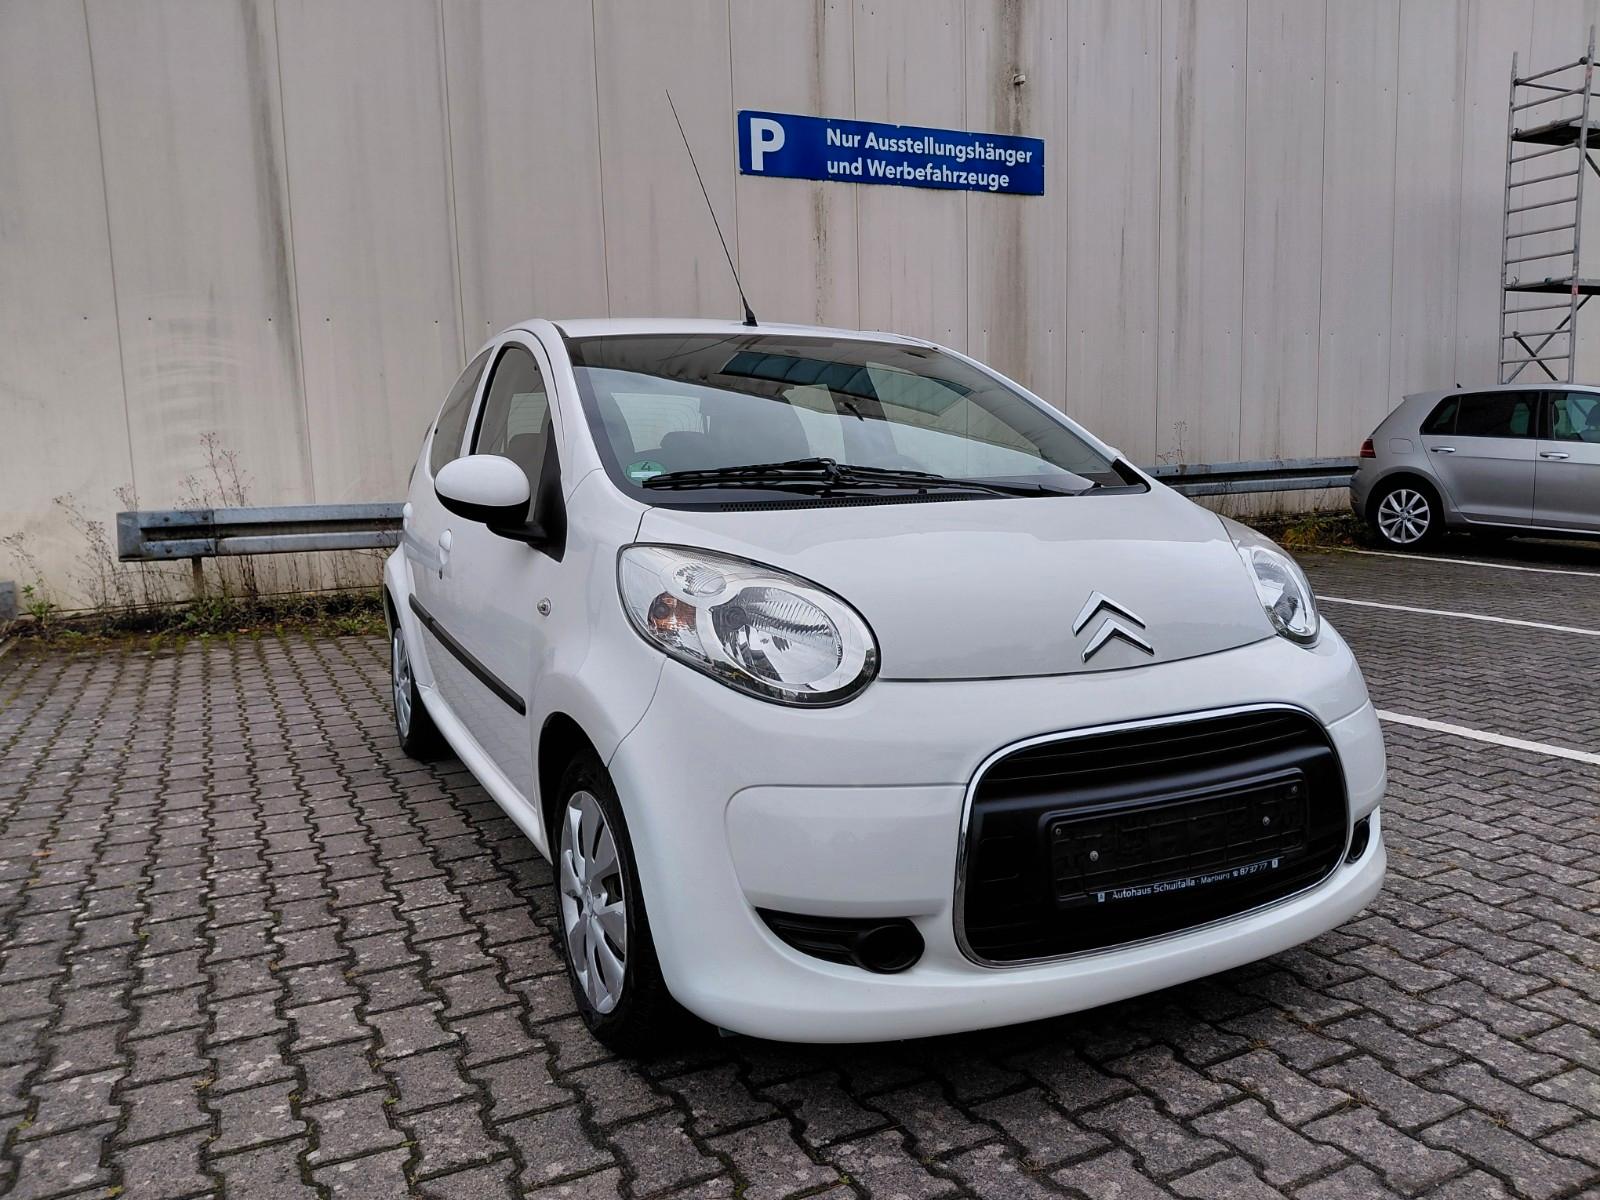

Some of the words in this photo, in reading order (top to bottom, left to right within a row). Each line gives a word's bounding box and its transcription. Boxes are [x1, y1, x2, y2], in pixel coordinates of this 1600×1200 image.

[750, 117, 786, 171] P
[826, 128, 861, 148] Nur
[864, 131, 1033, 167] Ausstellungshänger
[827, 157, 863, 176] und
[867, 158, 1010, 191] Werbefahrzeuge
[640, 461, 653, 471] 4
[1111, 886, 1152, 899] Autohaus
